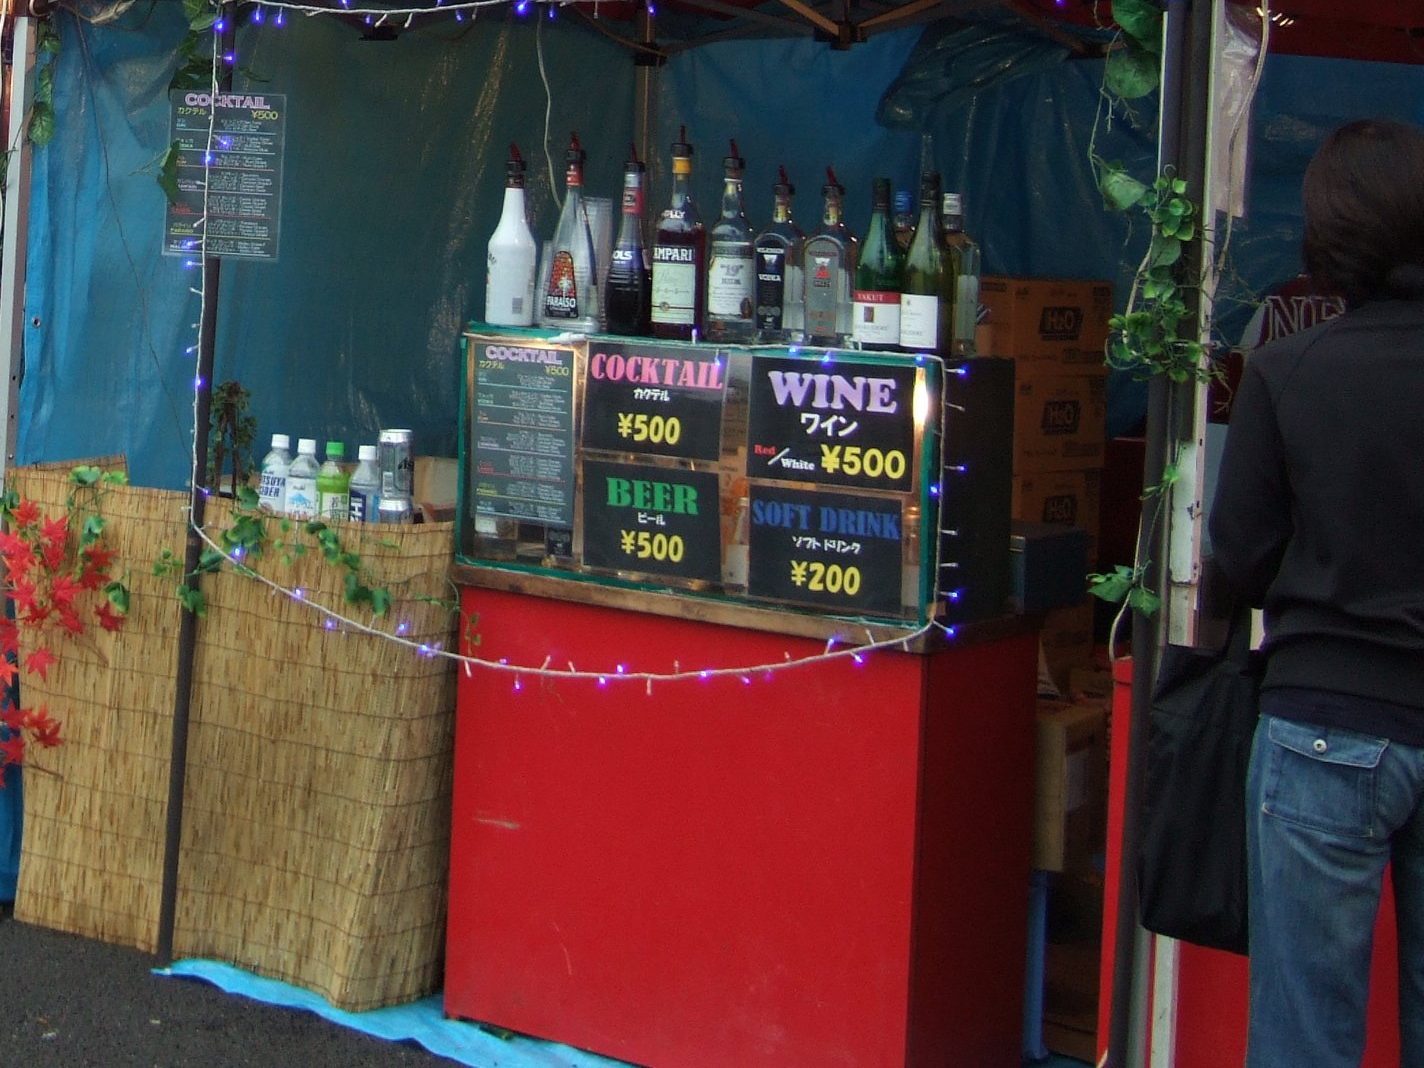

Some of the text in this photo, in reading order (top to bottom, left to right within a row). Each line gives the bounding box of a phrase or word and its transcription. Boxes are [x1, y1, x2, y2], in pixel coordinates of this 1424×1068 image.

[184, 92, 271, 110] COCKTAIL
[251, 110, 279, 121] ¥500
[485, 345, 563, 366] COCKTAIL
[544, 364, 570, 377] ¥500
[591, 353, 723, 390] COCKTAIL
[633, 388, 671, 402] カクテル
[767, 370, 898, 414] WINE
[618, 412, 681, 445] ¥500
[800, 412, 859, 437] ワイン
[820, 443, 907, 480] ¥500
[605, 476, 699, 516] BEER
[637, 511, 666, 526] ビール
[752, 499, 901, 541] SOFT DRINK
[621, 529, 684, 563] ¥500
[792, 535, 862, 556] ソフト ドリンク
[790, 559, 861, 596] ¥200
